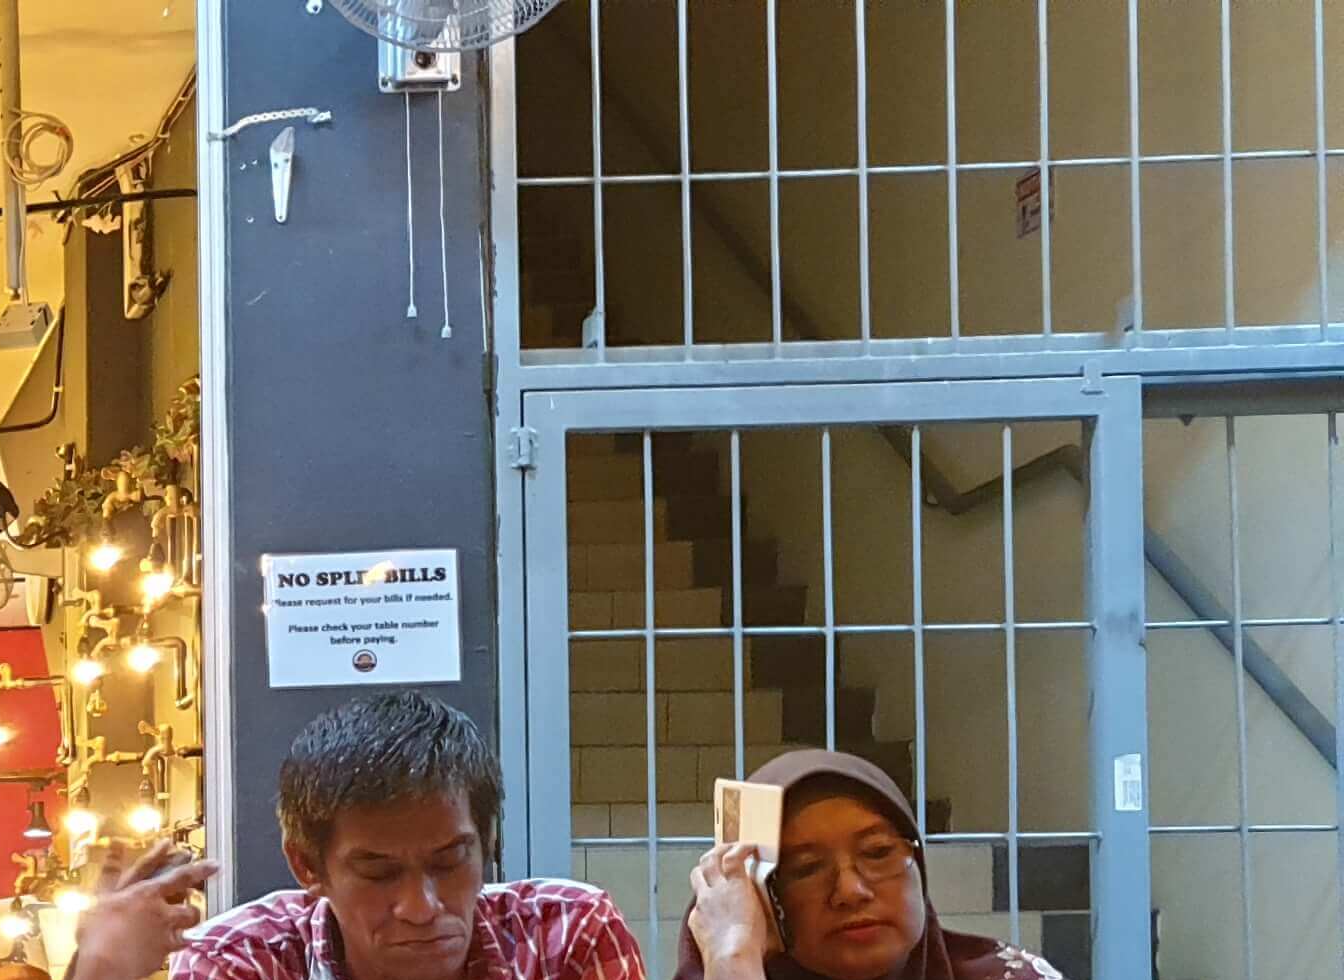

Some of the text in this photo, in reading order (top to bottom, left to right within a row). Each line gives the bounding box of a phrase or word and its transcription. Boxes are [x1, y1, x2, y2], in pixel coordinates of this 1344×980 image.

[277, 567, 446, 588] NO SPLI BILLS
[305, 597, 341, 608] request
[344, 595, 358, 605] for
[360, 596, 382, 606] your
[384, 594, 403, 603] bills
[406, 593, 413, 602] if
[414, 592, 453, 602] needed.
[288, 619, 439, 633] Please check your table number
[330, 635, 397, 645] before paying.
